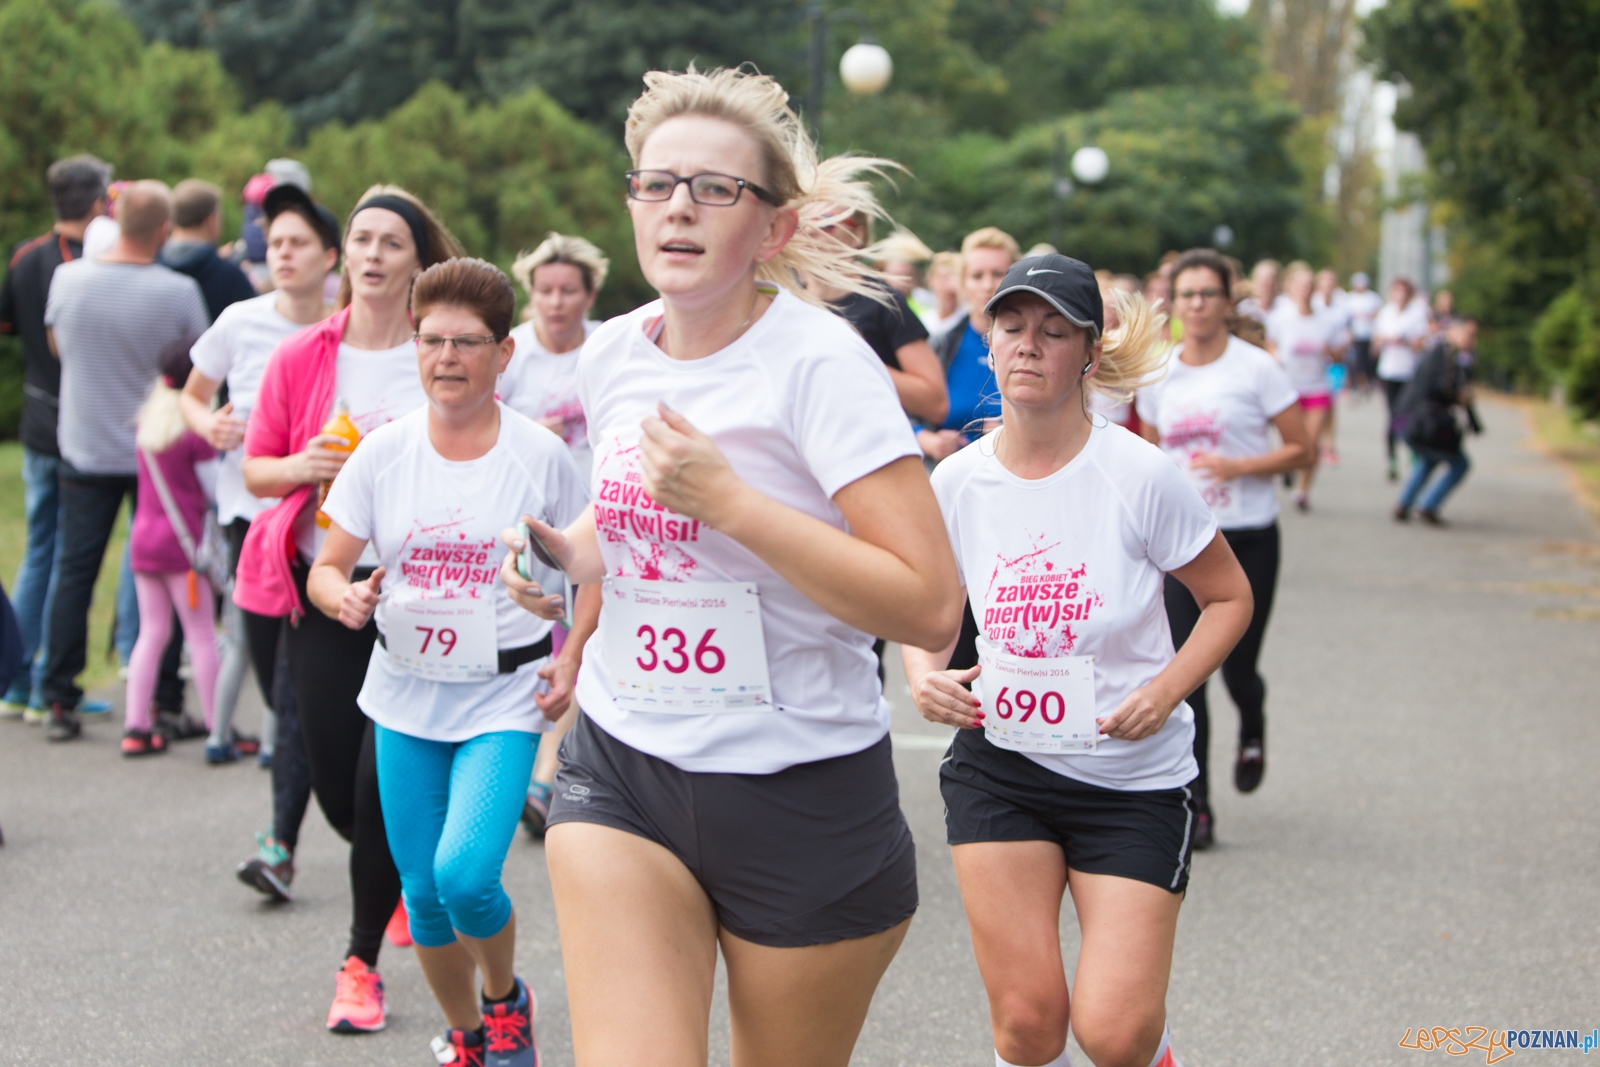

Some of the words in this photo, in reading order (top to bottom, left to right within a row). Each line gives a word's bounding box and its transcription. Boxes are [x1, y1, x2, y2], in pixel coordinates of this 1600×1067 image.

[599, 478, 678, 515] zaws
[409, 547, 488, 566] zawsze
[407, 575, 431, 590] 2016
[1020, 575, 1038, 583] BIEG
[1040, 573, 1068, 583] KOBIET
[995, 582, 1079, 603] zawsze
[700, 598, 727, 609] 2016
[414, 625, 457, 657] 79
[988, 626, 1016, 641] 2016
[636, 624, 726, 674] 336
[995, 663, 1016, 674] Zawsze
[1017, 667, 1048, 678] Pier(w)si
[1049, 669, 1070, 677] 2016
[995, 686, 1066, 725] 690
